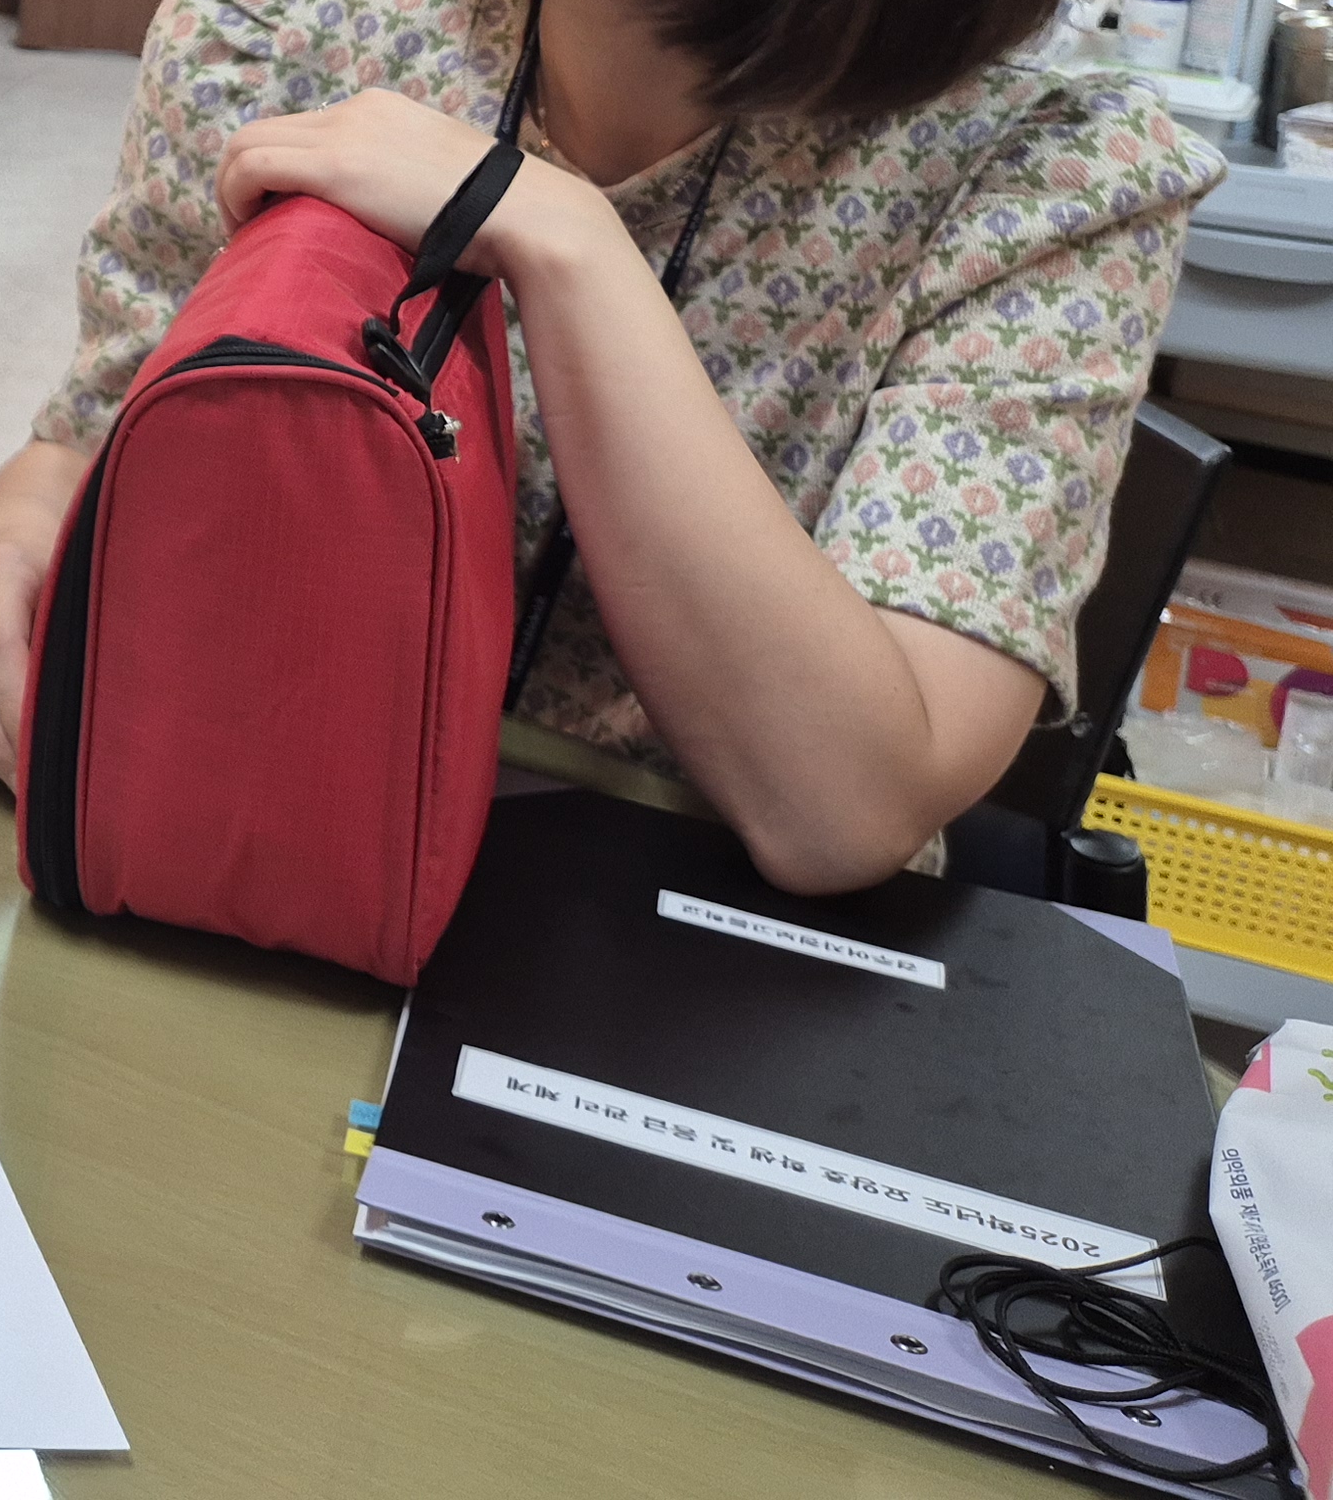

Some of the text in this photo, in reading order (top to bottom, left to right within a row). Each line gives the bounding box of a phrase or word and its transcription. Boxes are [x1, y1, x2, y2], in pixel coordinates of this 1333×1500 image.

[504, 1075, 1101, 1262] 2025학년도 요양호 학생 및 응급 관리 체계
[1221, 1148, 1254, 1200] 의약외품
